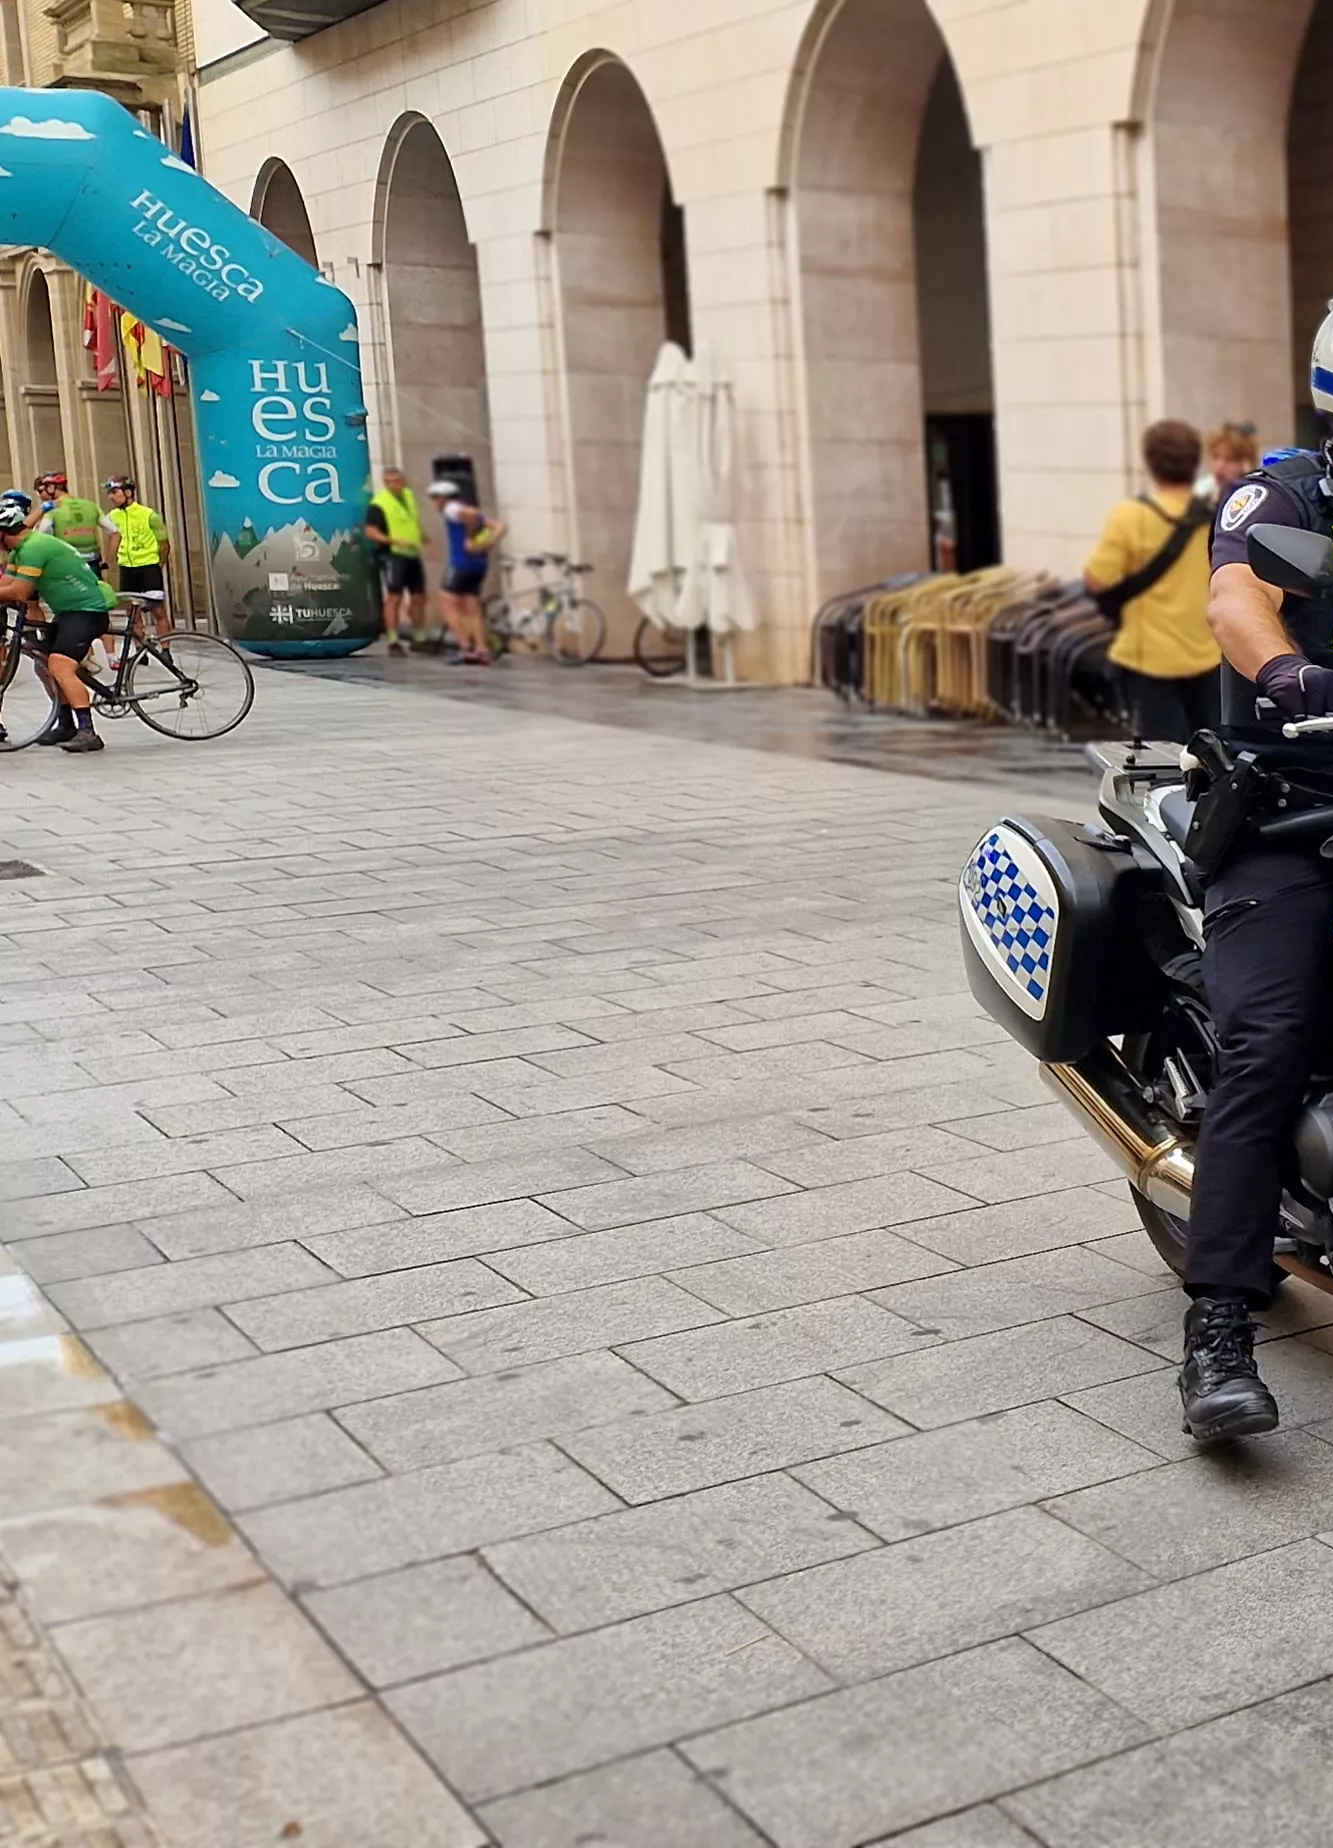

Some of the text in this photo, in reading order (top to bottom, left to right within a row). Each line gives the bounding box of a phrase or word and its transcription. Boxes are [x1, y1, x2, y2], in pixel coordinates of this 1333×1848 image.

[129, 188, 264, 303] Huesca
[248, 359, 332, 393] Hu
[252, 396, 335, 441] es
